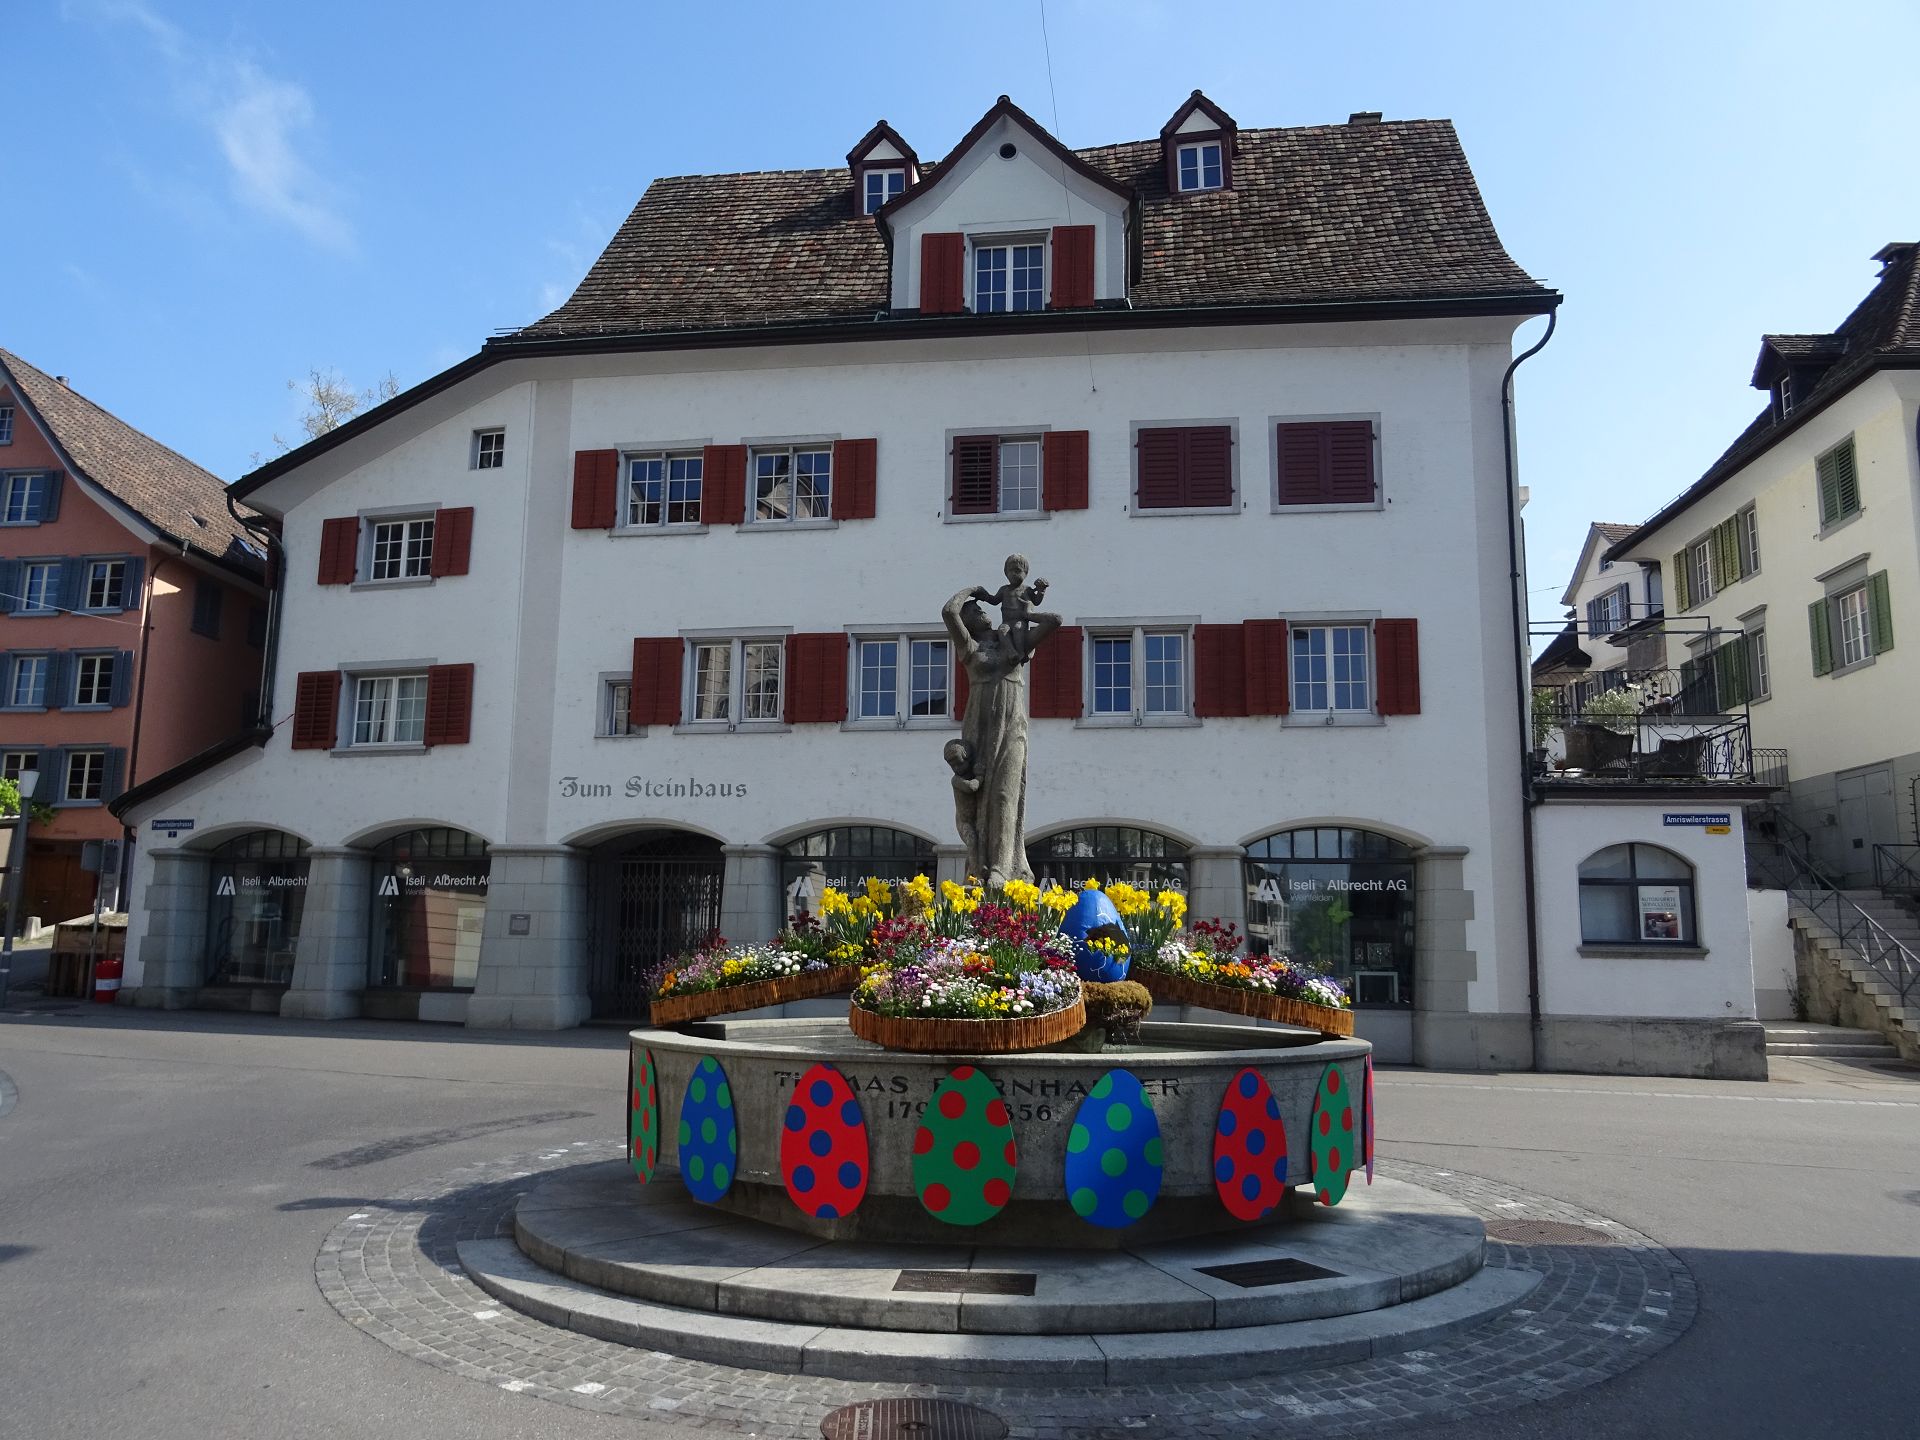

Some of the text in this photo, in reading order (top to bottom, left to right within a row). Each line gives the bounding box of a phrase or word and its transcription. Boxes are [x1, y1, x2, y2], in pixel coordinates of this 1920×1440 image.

[558, 775, 748, 798] Zum Steinhaus
[1666, 815, 1728, 823] Amriswilerstrasse
[242, 875, 261, 887] Iseli
[268, 875, 308, 887] Albrecht
[405, 875, 426, 886] Iseli
[433, 874, 476, 886] Albrecht
[857, 876, 908, 887] Alrecht
[1070, 877, 1092, 889] Ise
[1161, 877, 1182, 889] AG
[1288, 879, 1315, 891] Iseli
[1327, 879, 1382, 891] Albrecht
[1386, 879, 1408, 891] AG
[774, 1071, 1181, 1097] TAS RNHAER
